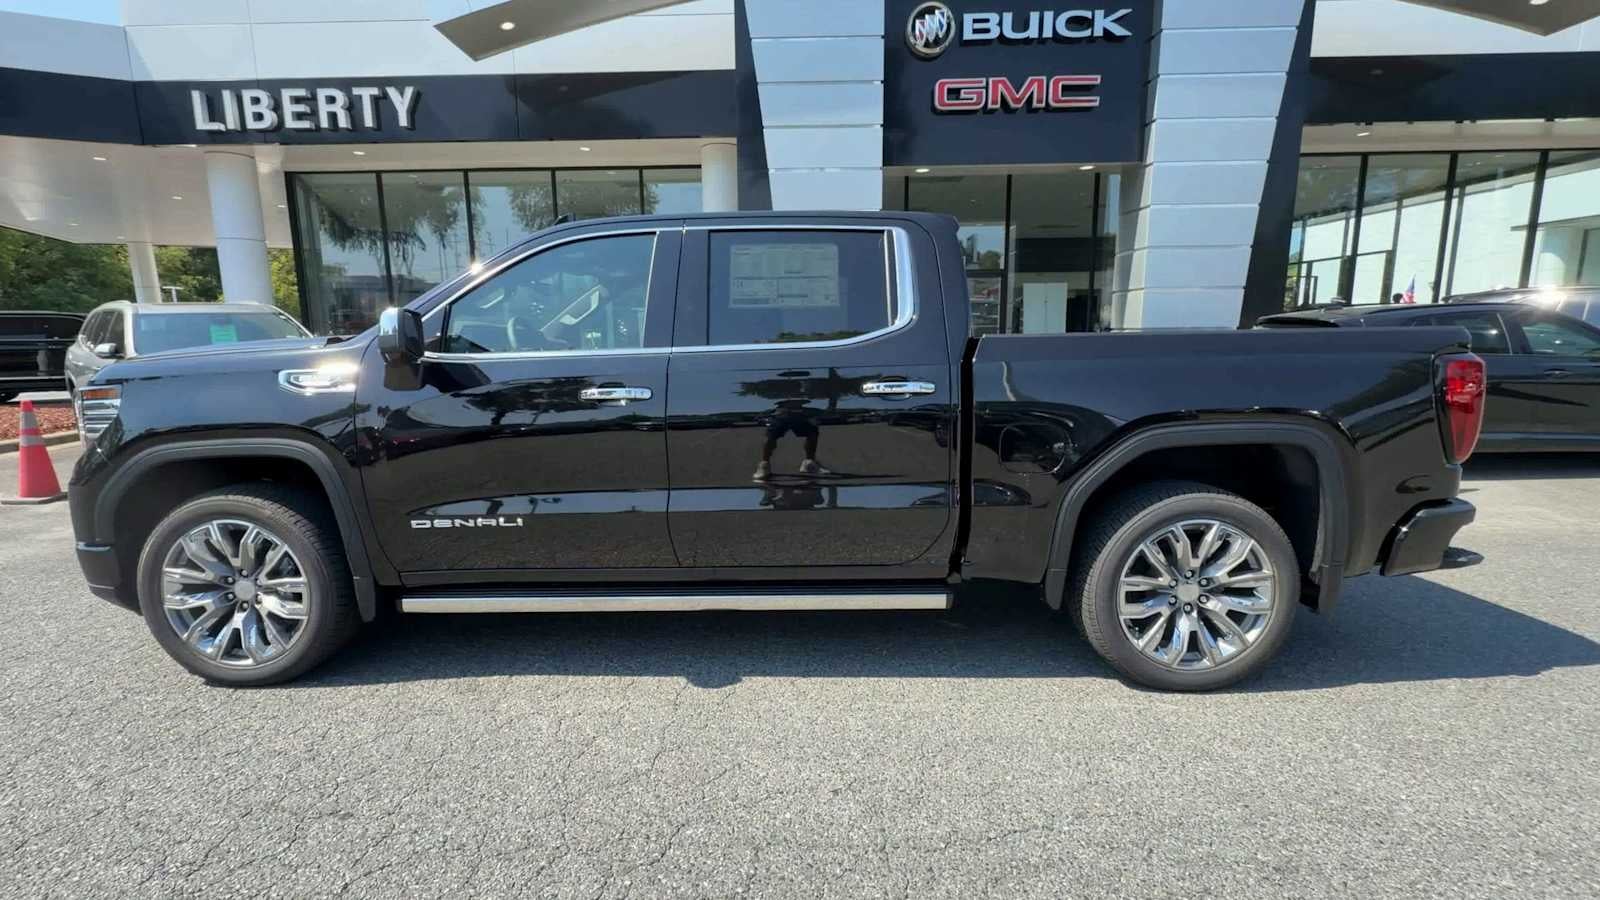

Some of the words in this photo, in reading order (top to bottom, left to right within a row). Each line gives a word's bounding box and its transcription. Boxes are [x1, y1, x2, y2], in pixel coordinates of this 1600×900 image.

[963, 9, 1133, 41] BUICK
[190, 86, 416, 132] LIBERTY
[934, 75, 1102, 110] GMC
[410, 517, 523, 528] DENALI
